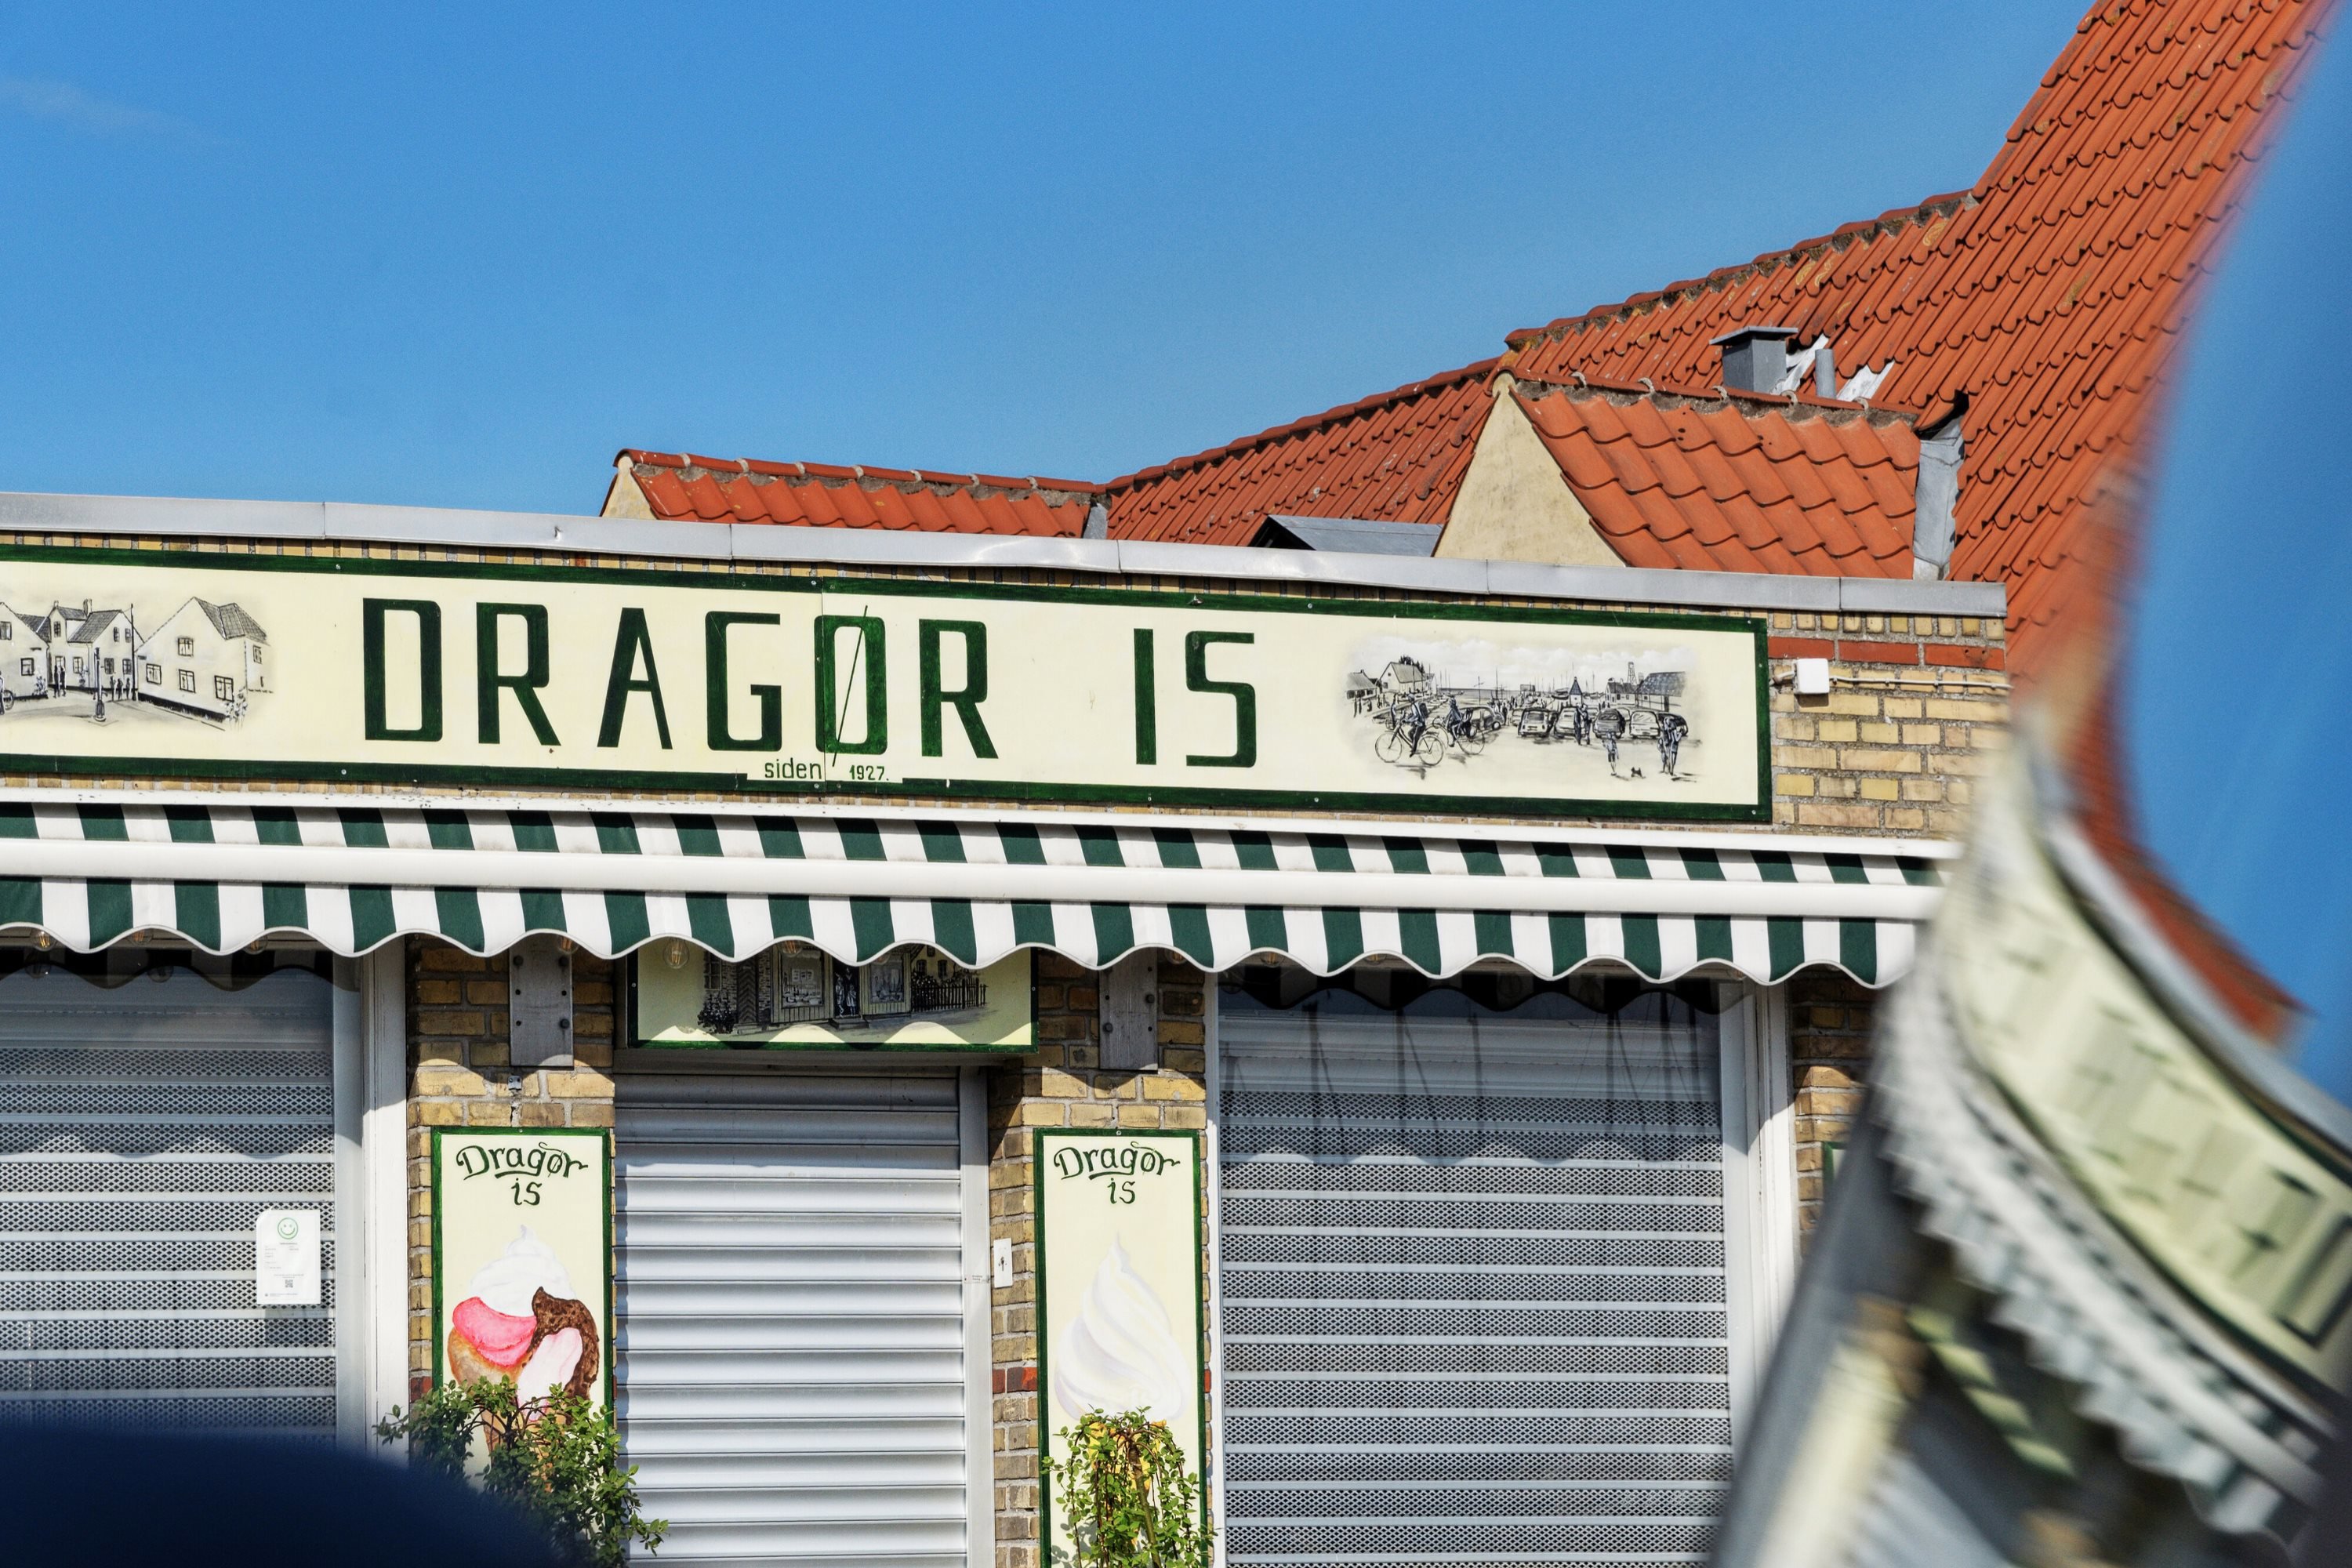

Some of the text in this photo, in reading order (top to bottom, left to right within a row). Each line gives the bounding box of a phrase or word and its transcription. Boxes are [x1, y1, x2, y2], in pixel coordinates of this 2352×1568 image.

[363, 597, 1257, 768] DRAGØR IS
[764, 757, 890, 781] siden 1927.
[456, 1142, 589, 1181] Dragør
[510, 1178, 543, 1207] is
[1107, 1177, 1136, 1205] is
